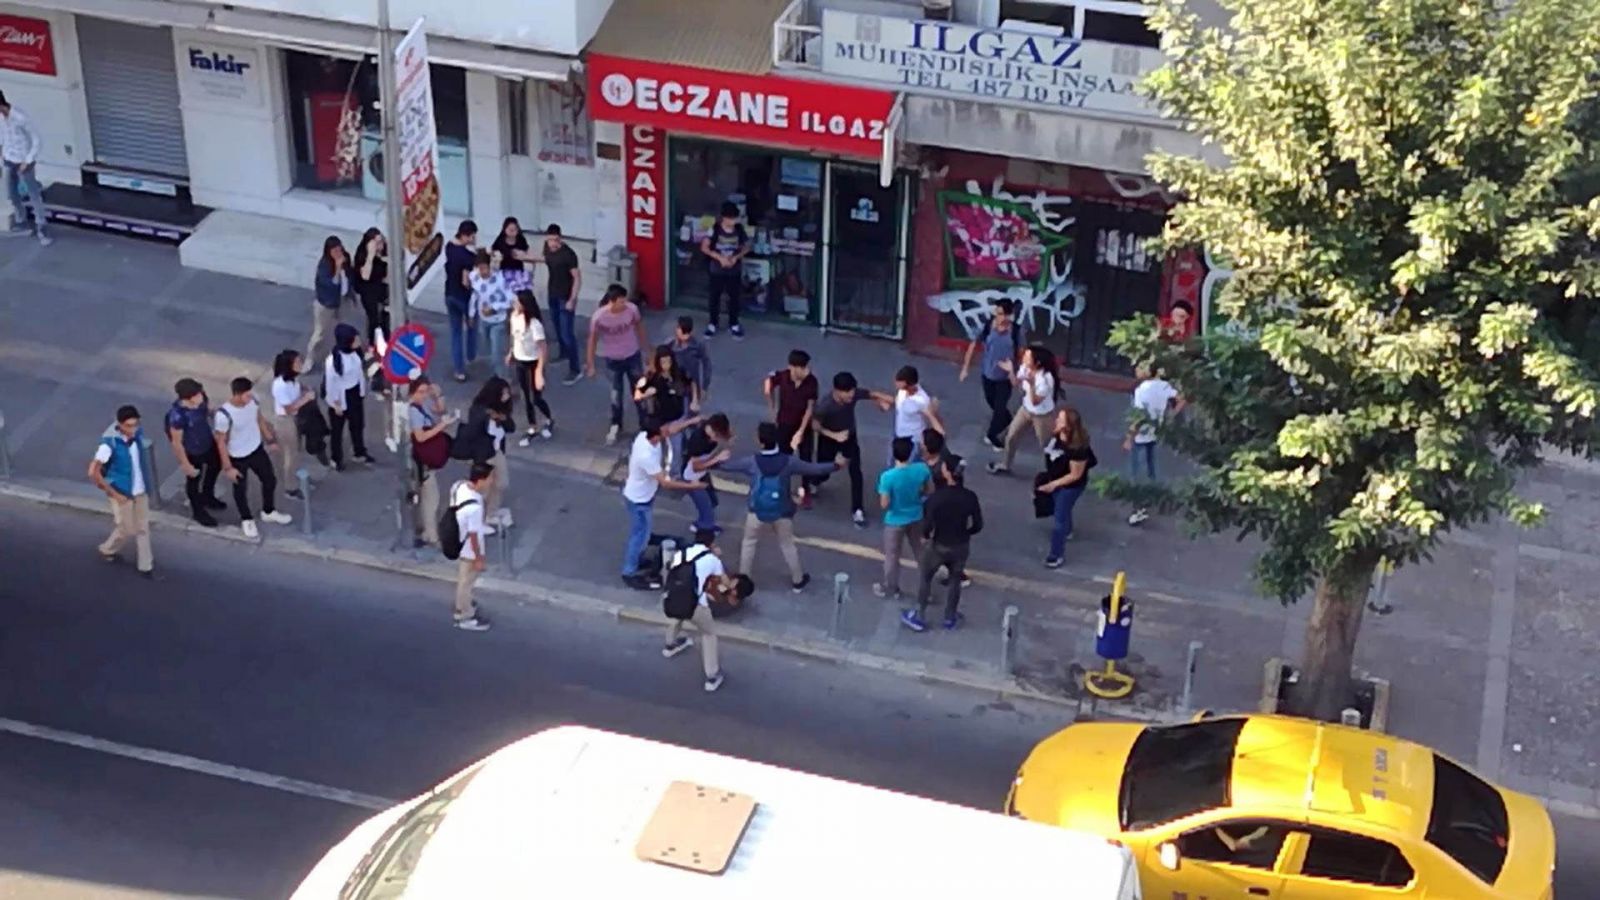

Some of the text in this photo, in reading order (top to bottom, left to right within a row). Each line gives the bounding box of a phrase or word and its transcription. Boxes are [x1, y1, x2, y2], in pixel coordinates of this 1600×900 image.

[188, 46, 250, 76] Fakir
[909, 20, 1083, 70] ILGAZ
[635, 77, 884, 140] ECZANE ILGAZ
[897, 68, 1088, 108] TEL 487 19 97
[632, 124, 656, 239] CZANE
